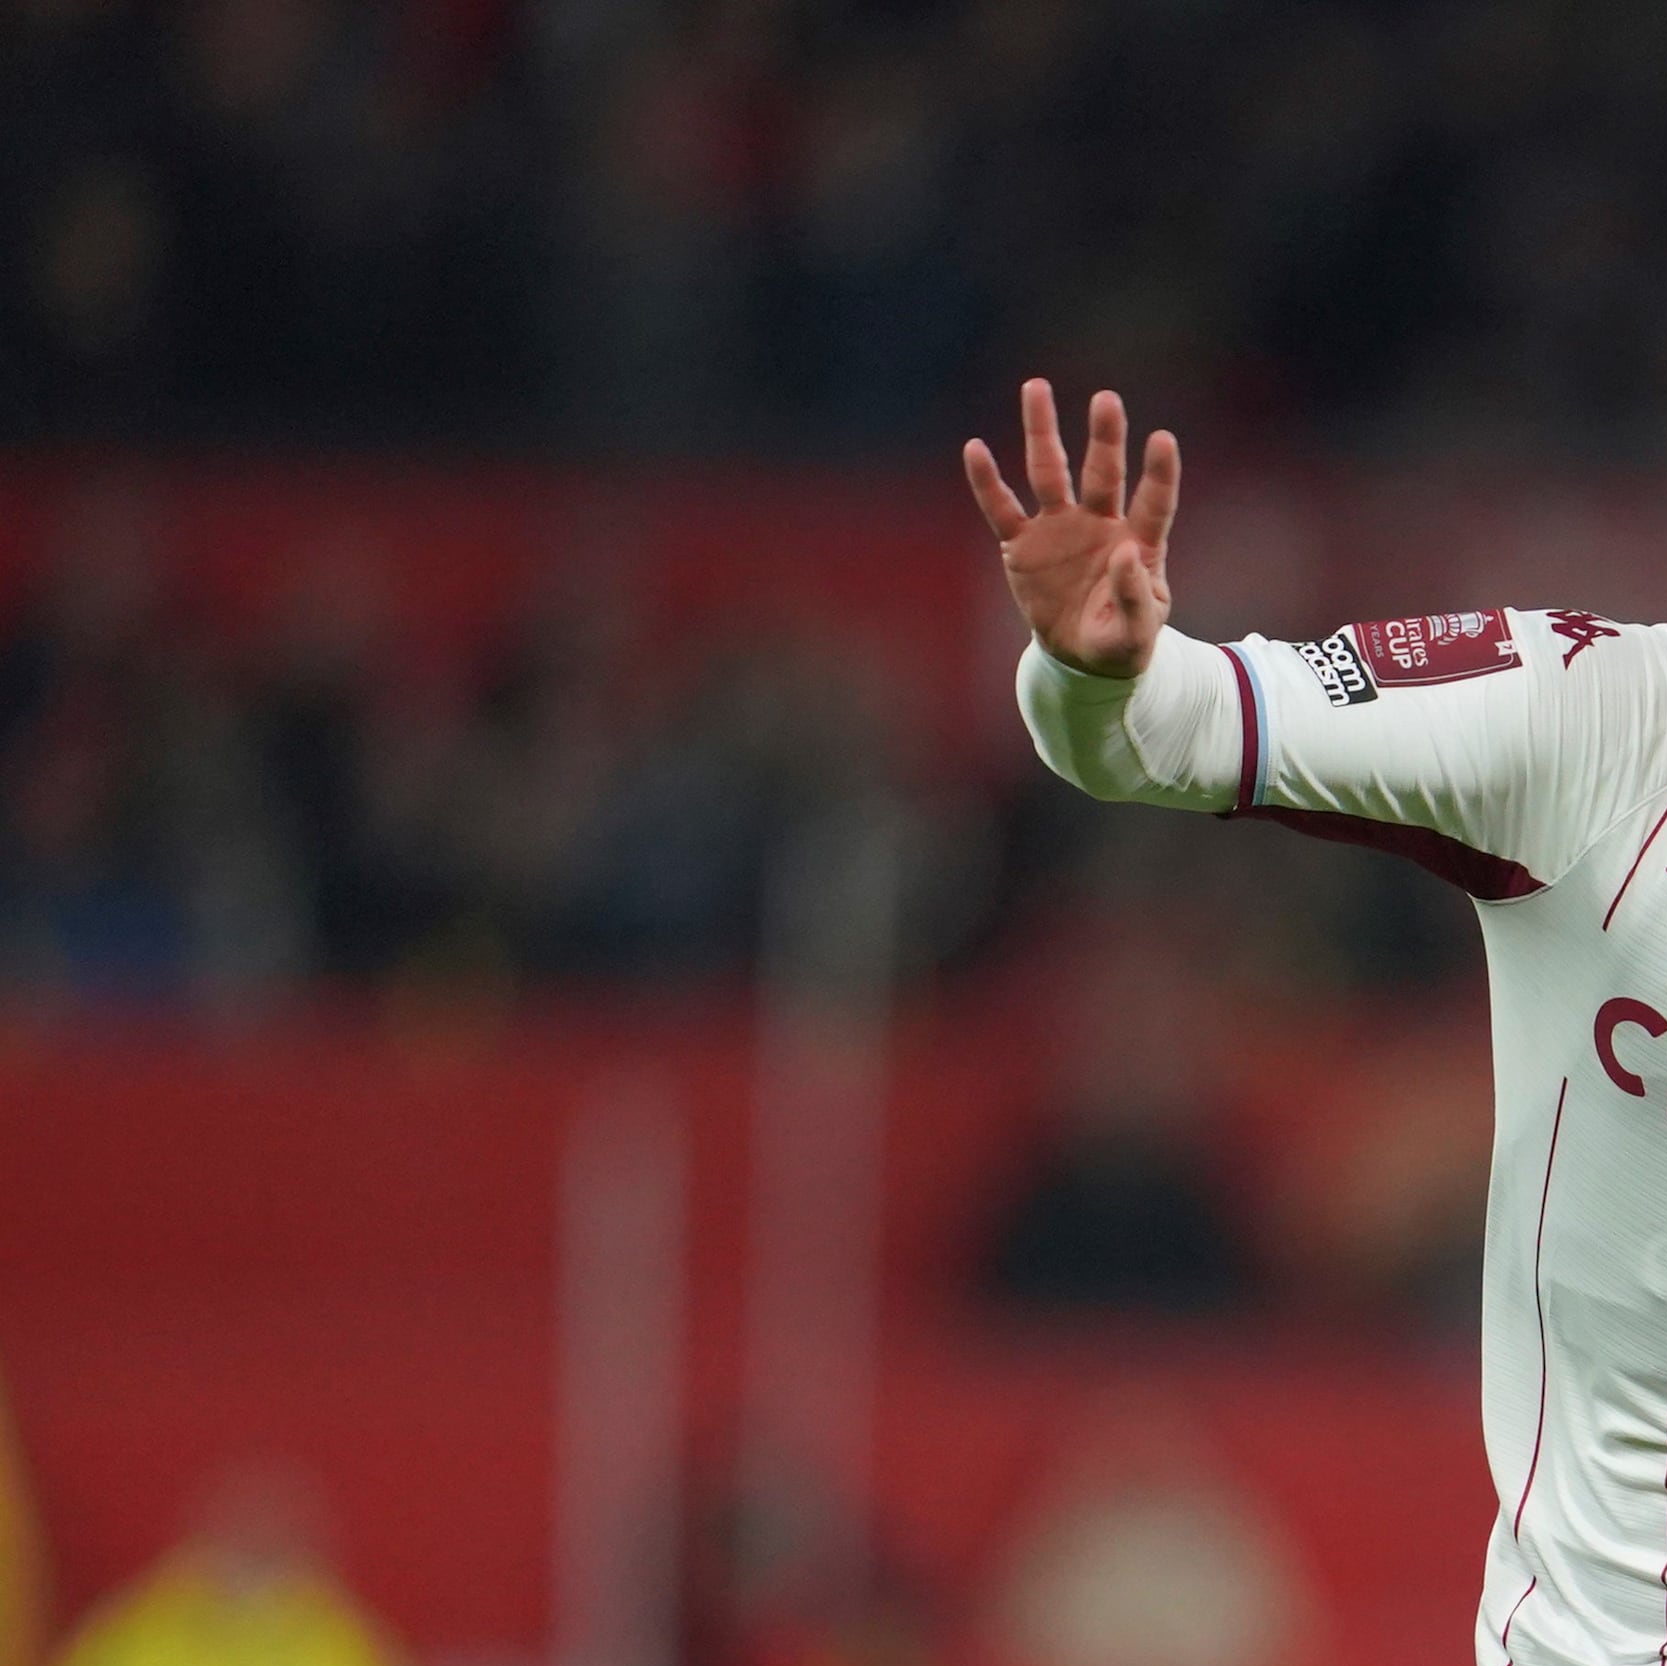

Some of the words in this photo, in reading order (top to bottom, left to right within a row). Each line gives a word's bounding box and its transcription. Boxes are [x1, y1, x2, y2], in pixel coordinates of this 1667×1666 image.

[1321, 633, 1367, 692] oom
[1369, 623, 1385, 658] YEARS
[1385, 620, 1413, 669] CUP
[1299, 641, 1350, 707] acism
